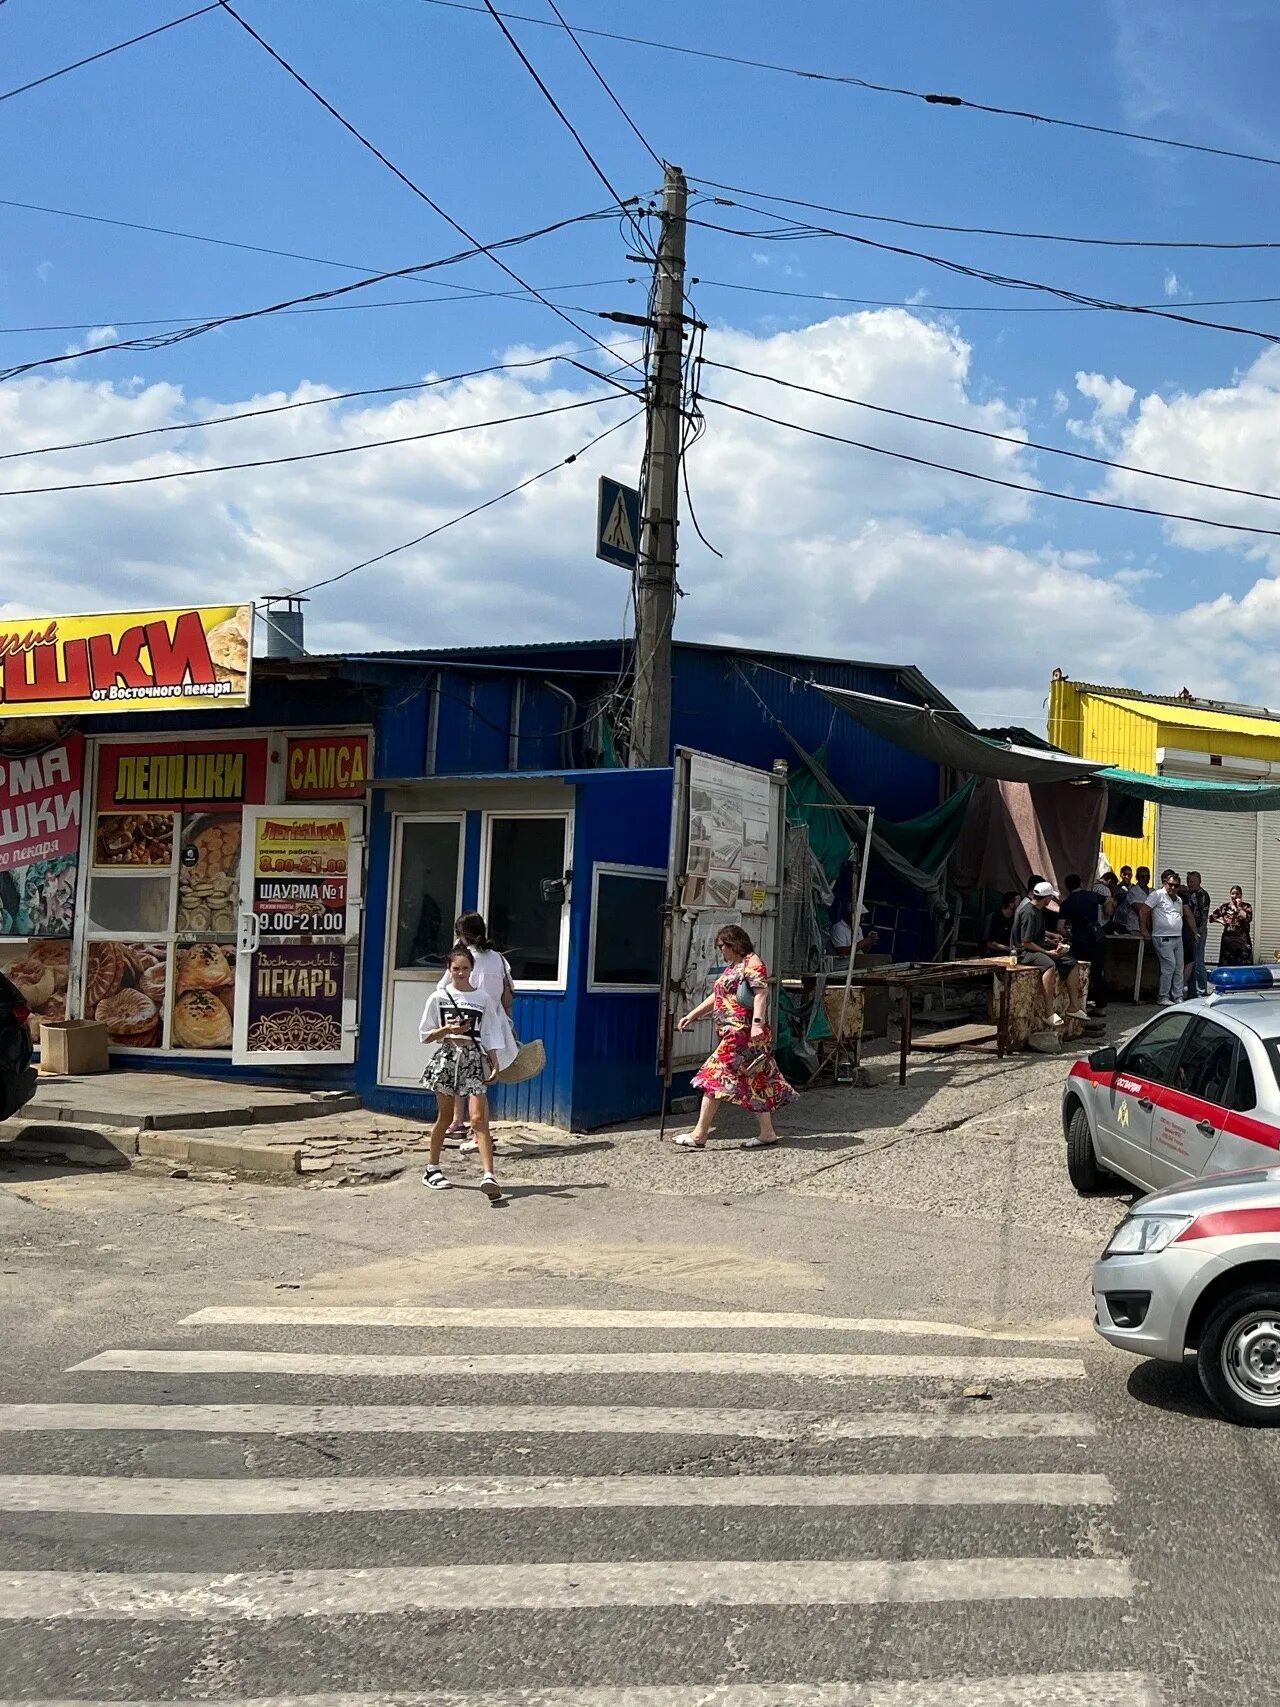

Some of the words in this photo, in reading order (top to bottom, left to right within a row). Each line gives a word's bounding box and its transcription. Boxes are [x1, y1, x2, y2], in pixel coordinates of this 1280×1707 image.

[0, 610, 217, 703] ШКИ
[92, 688, 107, 700] от
[109, 685, 182, 699] Восточного
[184, 682, 231, 697] пекаря
[290, 746, 364, 789] САМСА
[13, 839, 59, 863] пекаря
[260, 884, 319, 899] ШАУРМА
[260, 913, 343, 930] 9.00-21.00
[258, 952, 339, 967] Восточный
[257, 969, 337, 997] ПЕКАРЬ
